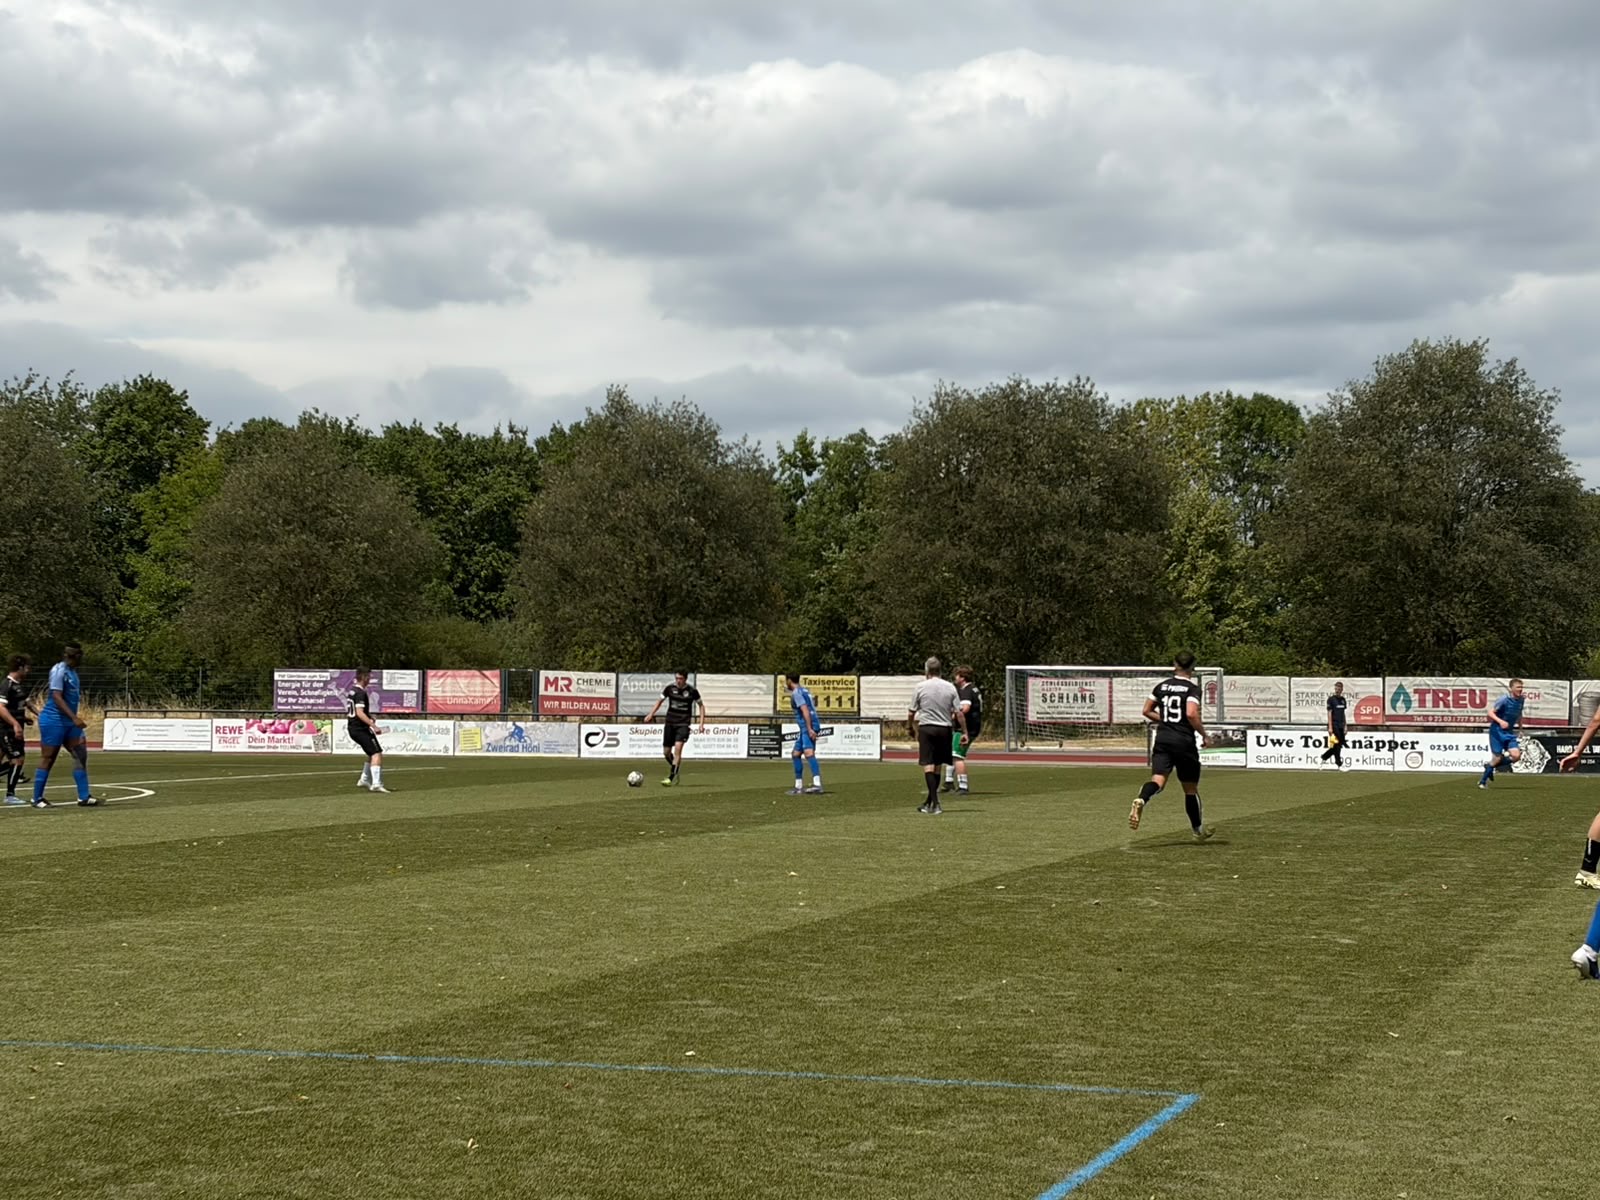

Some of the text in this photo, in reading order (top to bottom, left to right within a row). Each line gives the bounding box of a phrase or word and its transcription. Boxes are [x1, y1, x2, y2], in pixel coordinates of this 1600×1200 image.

[544, 676, 612, 692] MR CHEMIE
[621, 679, 662, 692] Apollo
[803, 678, 855, 686] Taxiservice
[1041, 693, 1095, 703] SCHLANG
[1413, 688, 1488, 709] TREU
[543, 700, 611, 711] WIR BILDEN AUS!
[1161, 695, 1182, 722] 19
[1360, 706, 1381, 714] SPD
[215, 726, 244, 735] REWE
[629, 726, 663, 737] Skupien
[712, 727, 740, 735] GmbH
[248, 736, 294, 744] Dein Markt!
[1256, 735, 1295, 747] Uwe
[486, 743, 519, 753] Zweirad
[1430, 744, 1460, 752] 02301
[1256, 753, 1295, 764] sanitär
[1362, 754, 1394, 766] klima
